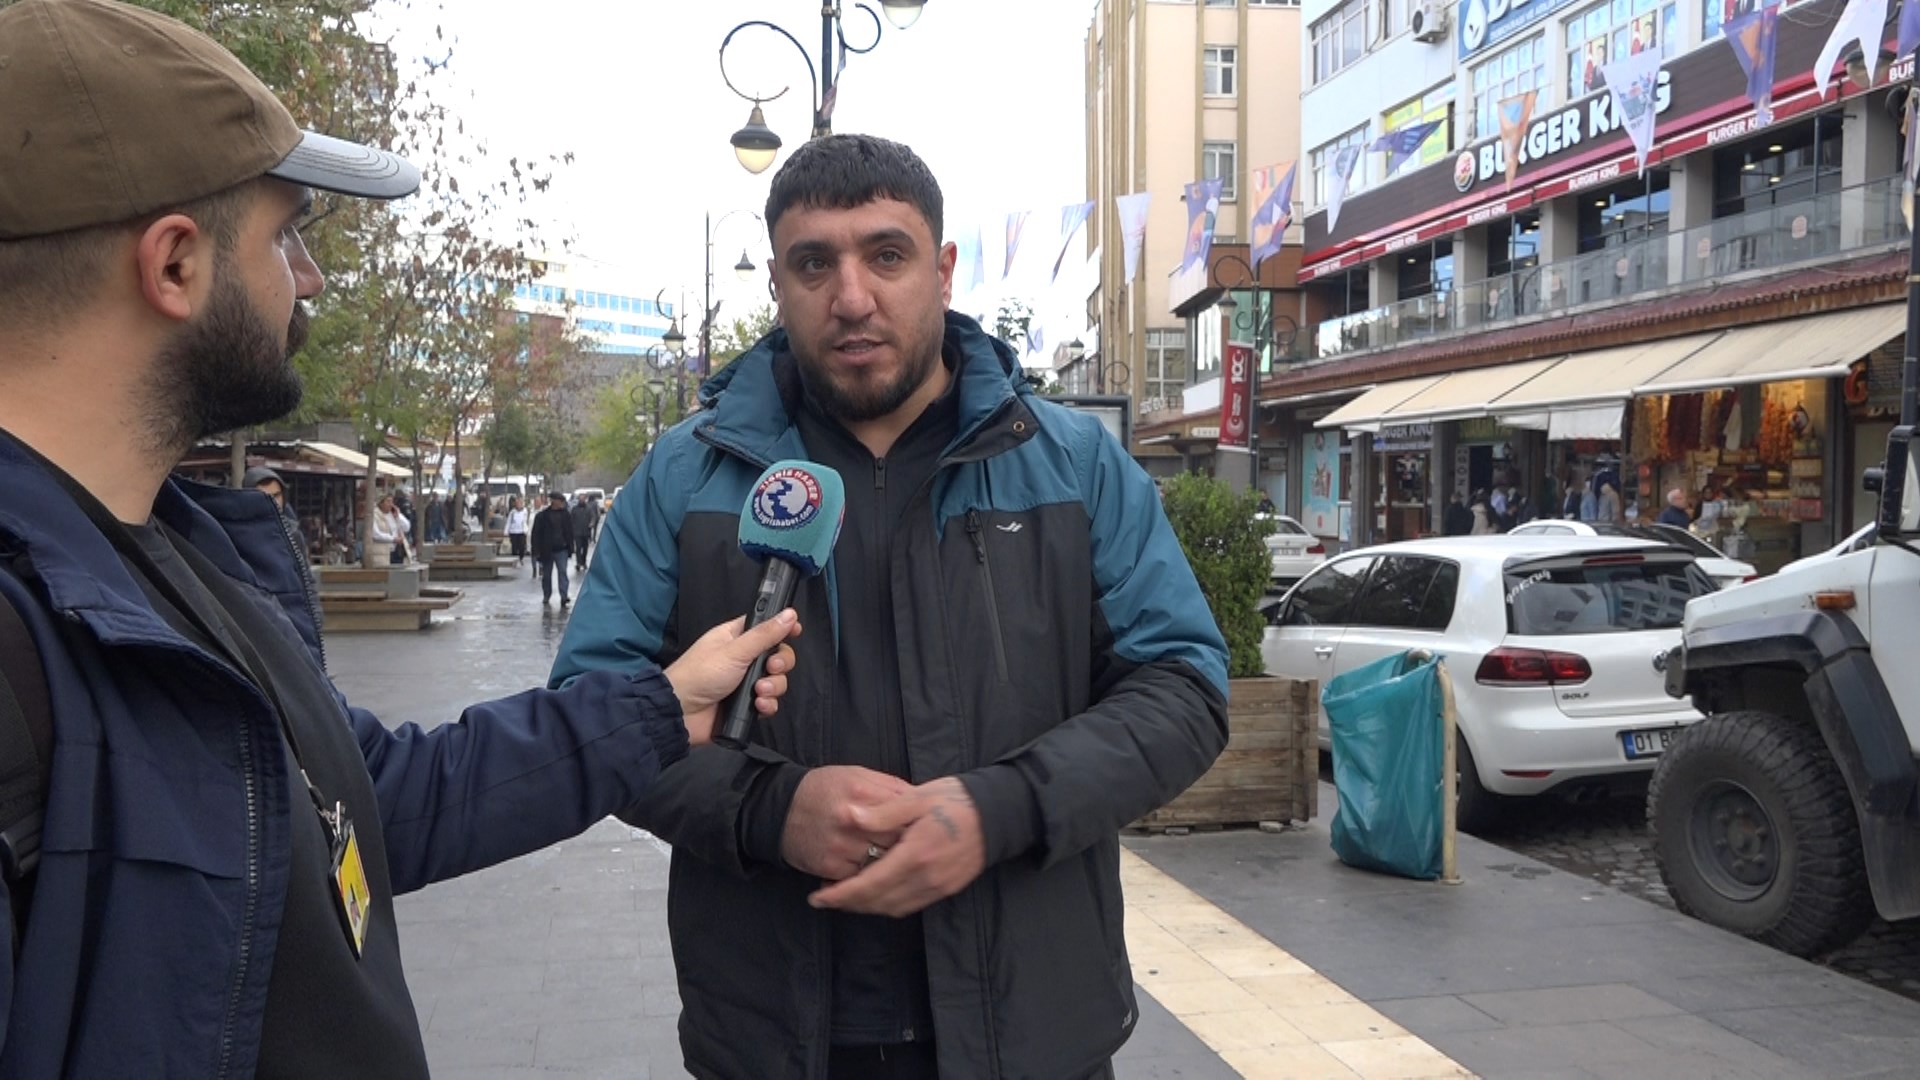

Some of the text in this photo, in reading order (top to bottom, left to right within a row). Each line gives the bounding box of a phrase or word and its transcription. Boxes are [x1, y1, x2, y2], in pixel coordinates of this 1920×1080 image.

[1479, 71, 1671, 181] BUGER KIG
[1707, 120, 1747, 145] BURGER
[1568, 173, 1598, 191] BURGER
[1561, 692, 1590, 700] GOLF
